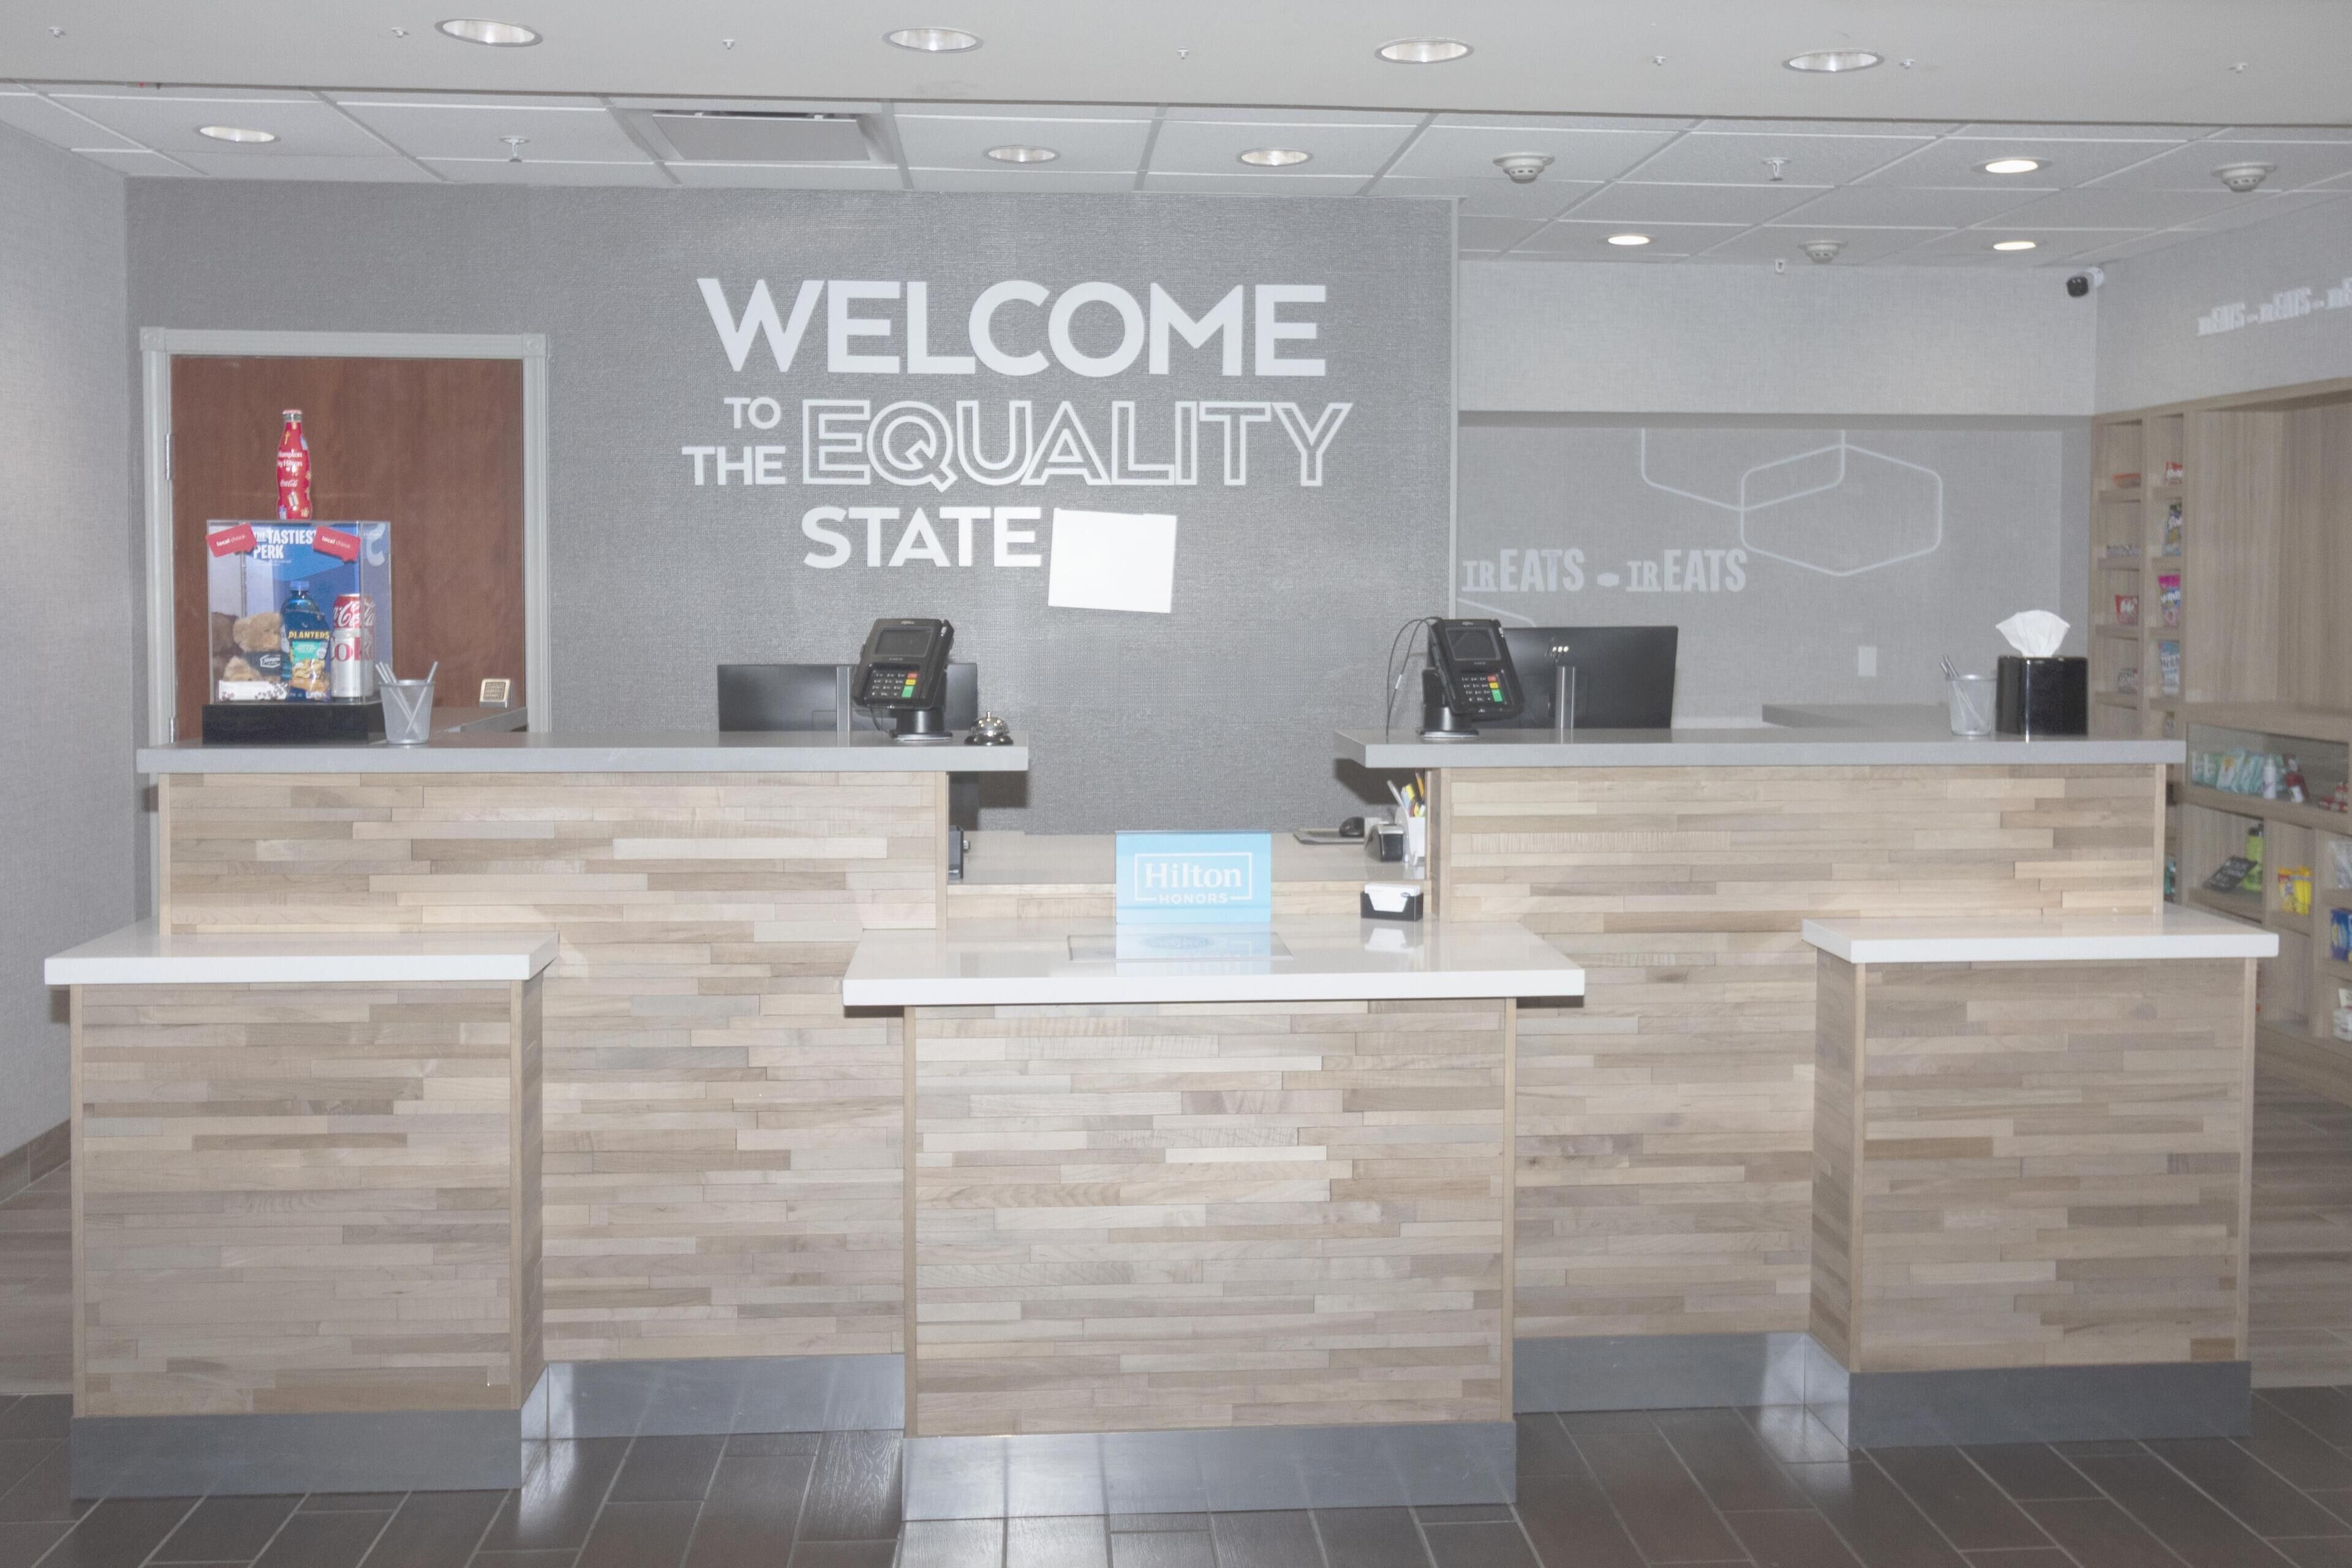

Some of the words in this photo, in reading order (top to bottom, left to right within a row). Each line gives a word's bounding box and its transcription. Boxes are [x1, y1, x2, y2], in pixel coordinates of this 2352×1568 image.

[696, 277, 1327, 377] WELCOME
[723, 396, 782, 429] TO
[681, 445, 786, 486] THE
[802, 398, 1353, 492] EQUALITY
[216, 538, 231, 547] local
[266, 529, 316, 545] TASTIES
[322, 536, 336, 545] local
[801, 506, 1042, 570] STATE
[253, 545, 284, 559] PERK
[1461, 549, 1585, 592] TREATS
[1626, 549, 1748, 592] TREATS
[288, 631, 330, 640] PLANTERS
[1144, 862, 1242, 888] Hilton
[1159, 893, 1228, 905] HONORS
